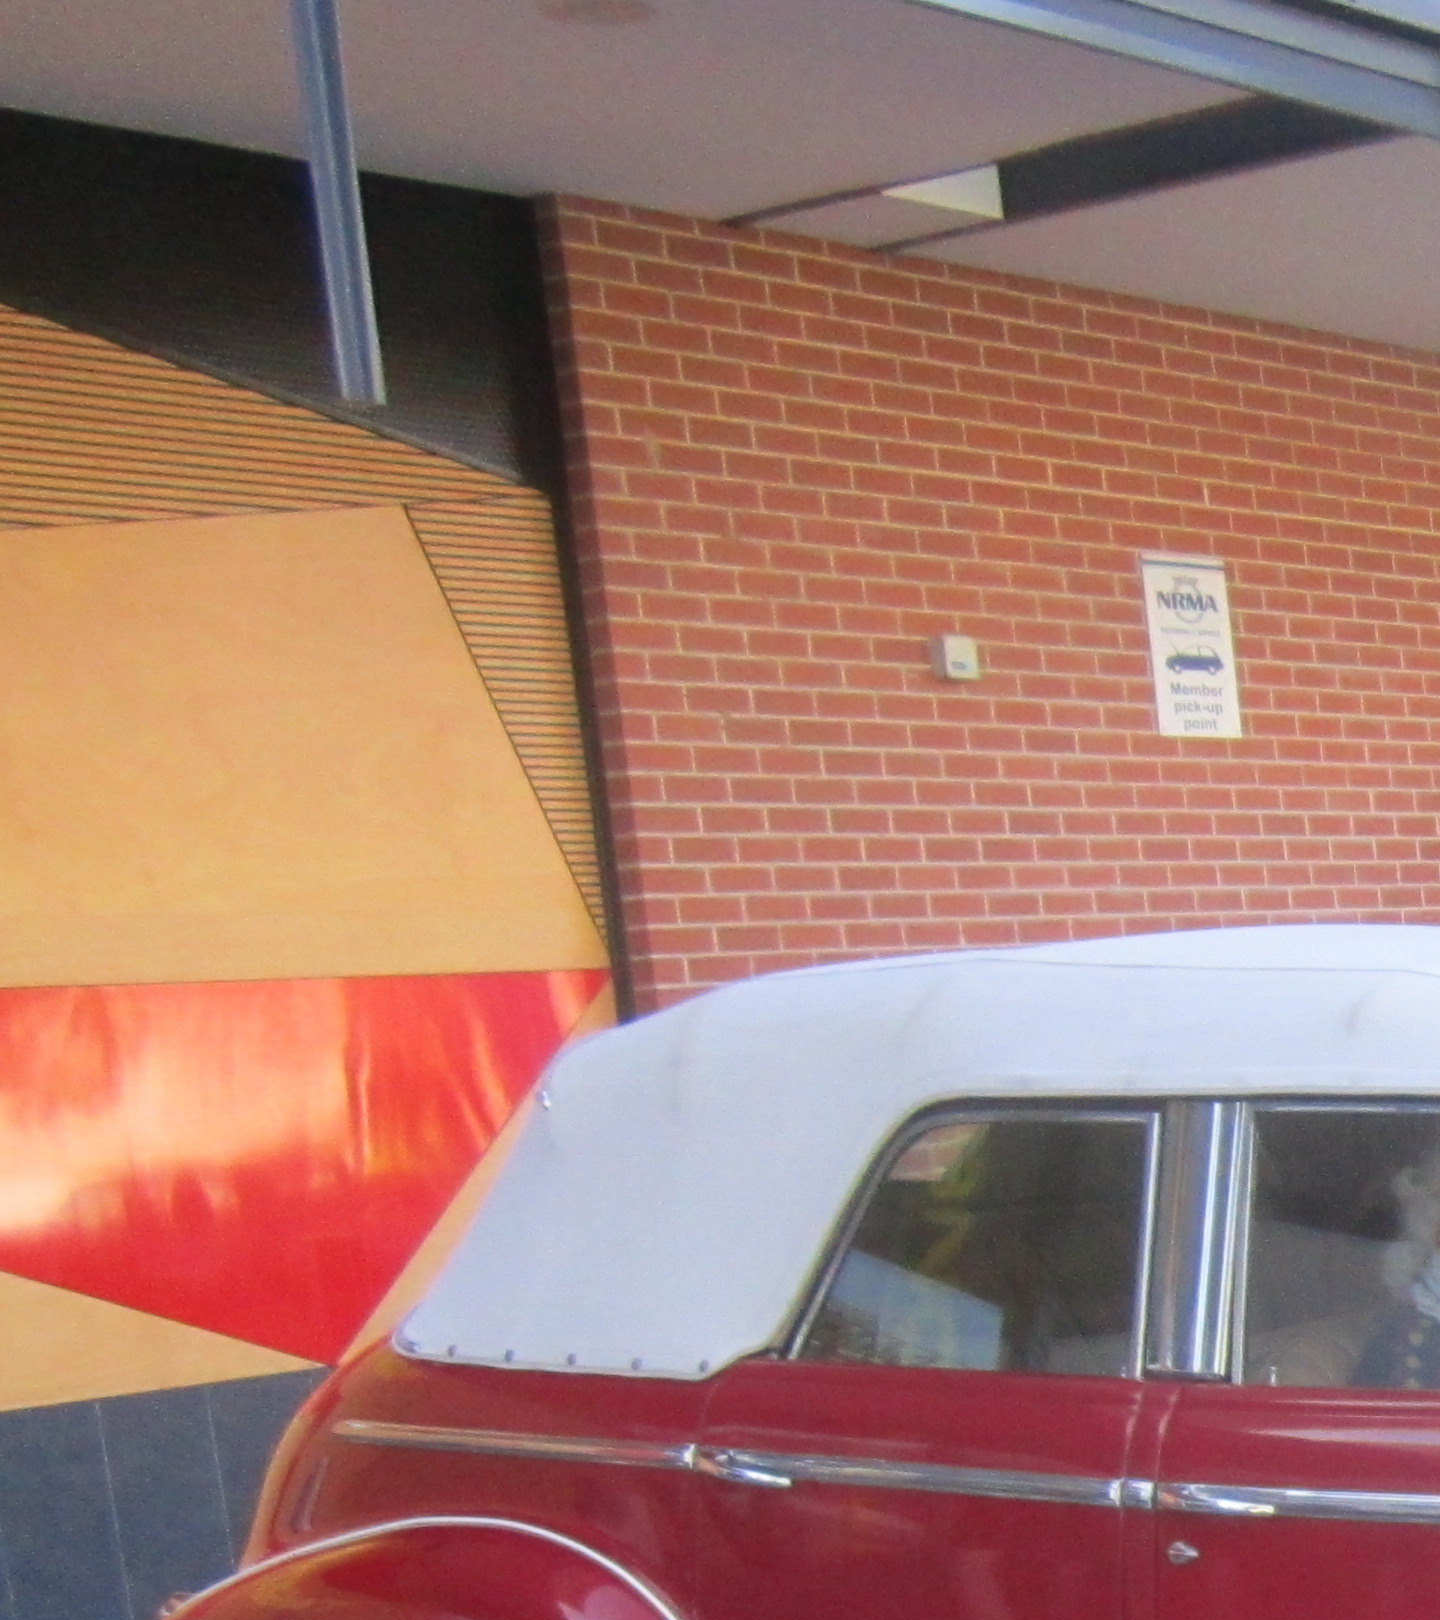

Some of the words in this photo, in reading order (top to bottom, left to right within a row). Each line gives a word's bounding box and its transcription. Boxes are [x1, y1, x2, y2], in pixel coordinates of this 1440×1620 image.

[1156, 590, 1219, 613] NRMA
[1170, 682, 1224, 698] Member
[1174, 701, 1223, 715] pick-up
[1183, 717, 1219, 731] point
